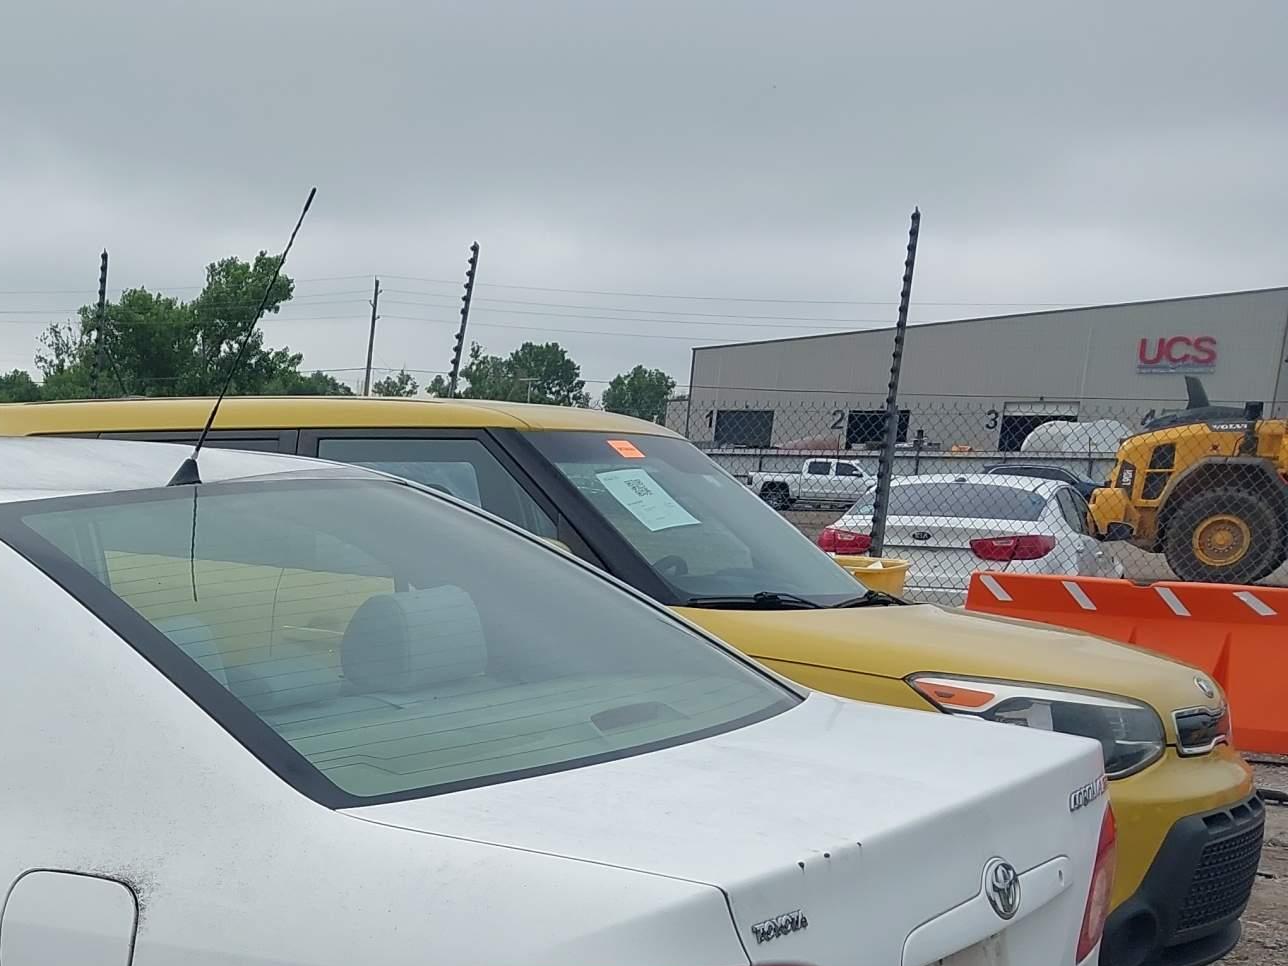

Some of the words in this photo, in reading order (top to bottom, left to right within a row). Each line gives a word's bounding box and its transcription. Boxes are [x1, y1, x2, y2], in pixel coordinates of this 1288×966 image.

[1138, 336, 1217, 364] UCS
[705, 410, 714, 428] 1
[831, 409, 846, 429] 2
[985, 410, 999, 430] 3
[752, 909, 808, 944] TOYOTA
